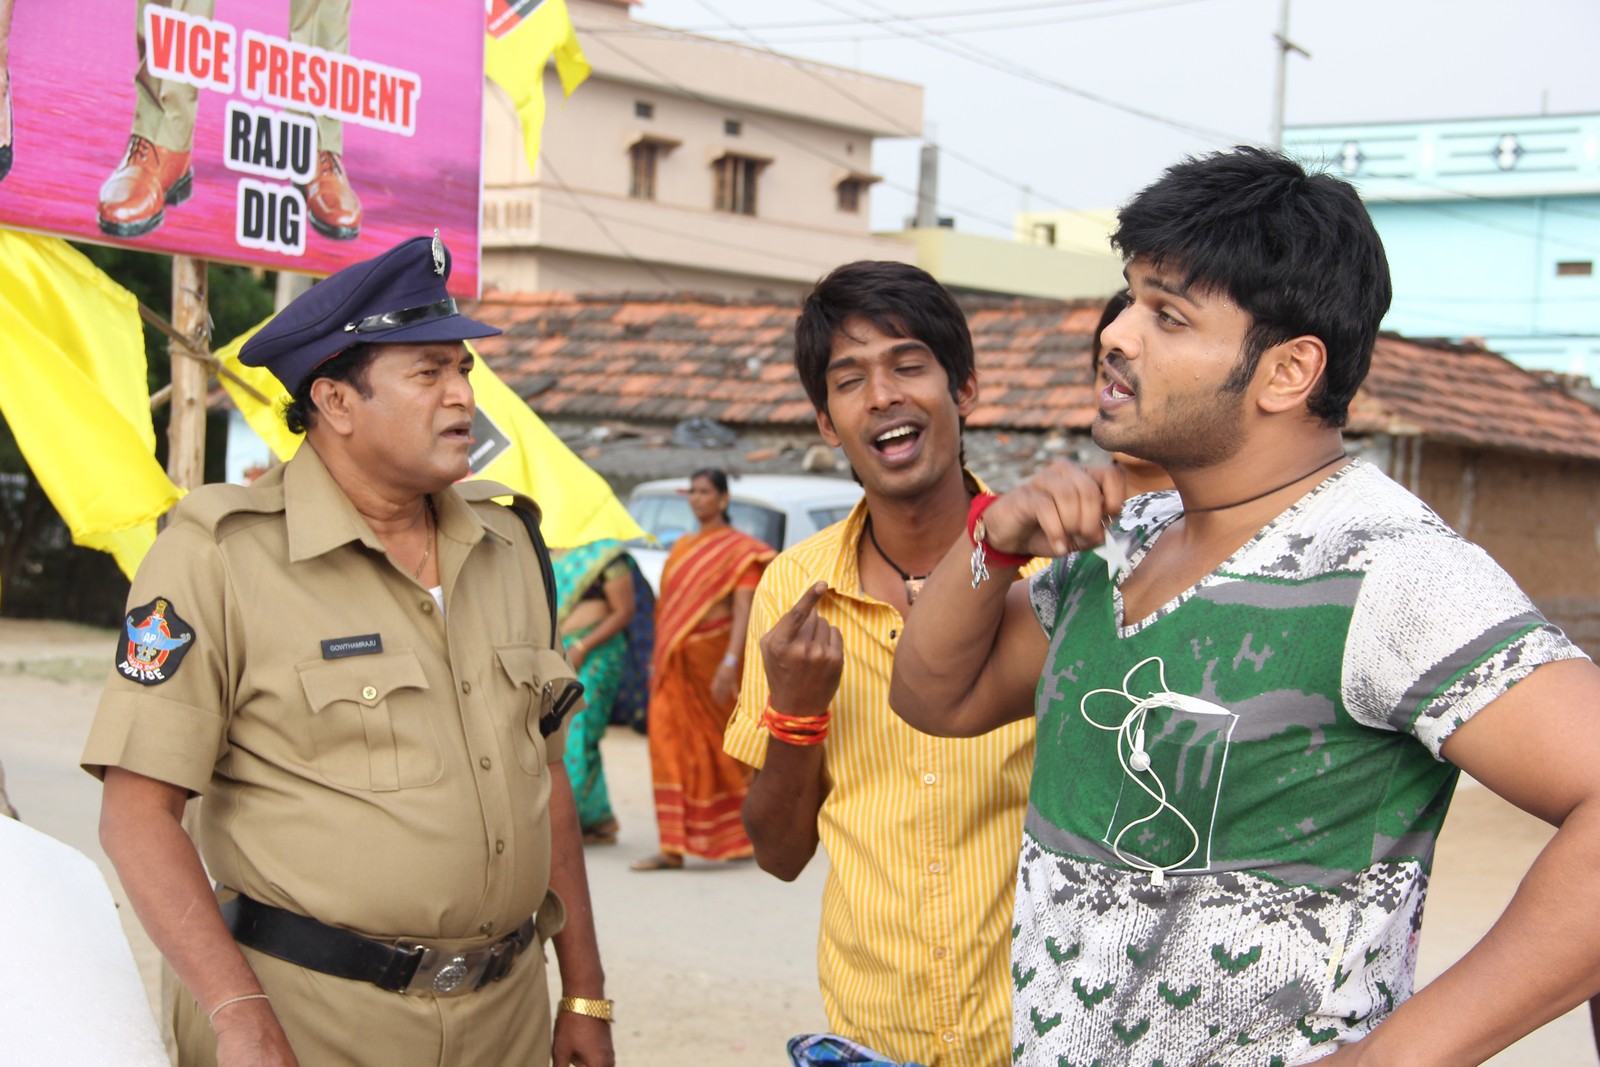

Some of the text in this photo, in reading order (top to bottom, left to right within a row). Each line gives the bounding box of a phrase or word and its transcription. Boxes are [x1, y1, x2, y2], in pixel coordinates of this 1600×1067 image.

[150, 13, 415, 128] VICE PRESIDENT
[230, 109, 312, 175] RAJU
[243, 187, 300, 247] DIG
[142, 632, 157, 643] AP
[329, 640, 377, 652] GOWTHAMRAJU
[118, 660, 165, 680] POLICE
